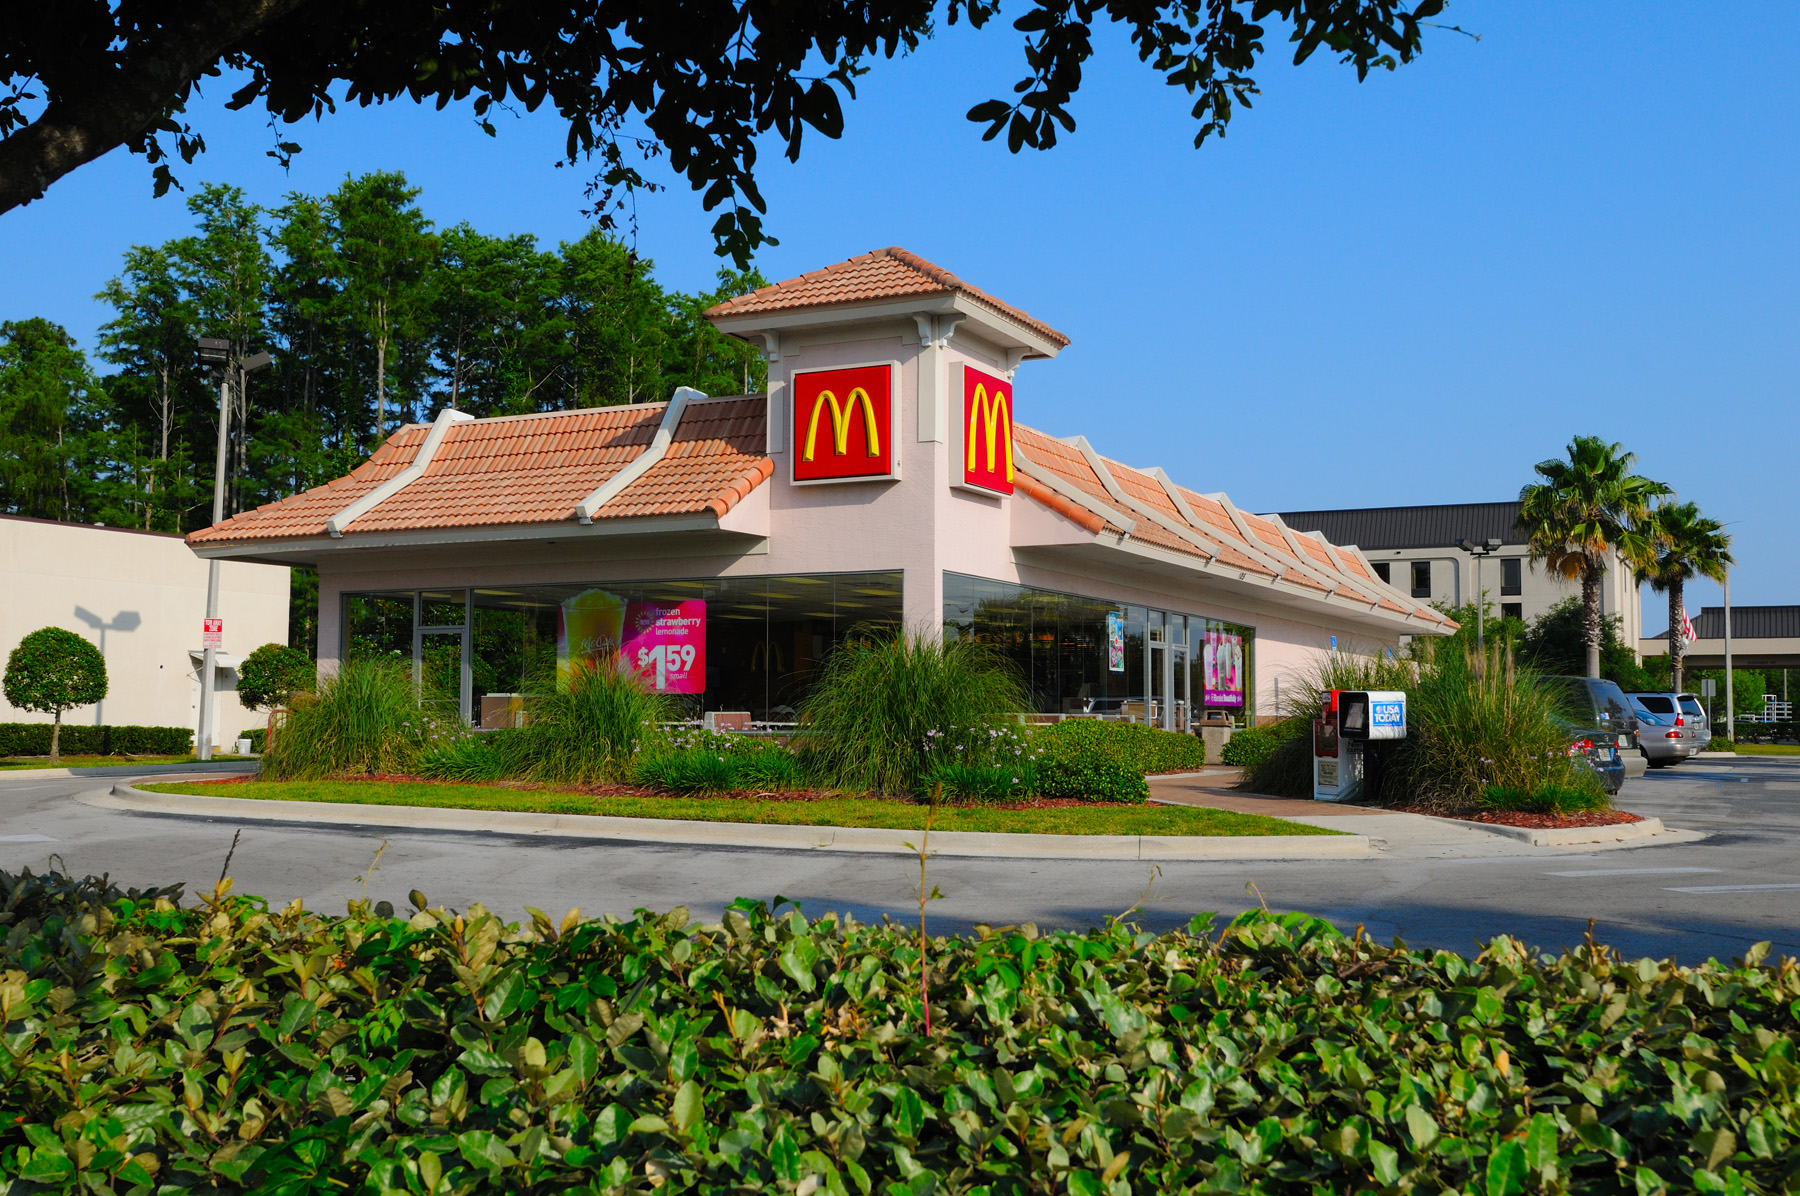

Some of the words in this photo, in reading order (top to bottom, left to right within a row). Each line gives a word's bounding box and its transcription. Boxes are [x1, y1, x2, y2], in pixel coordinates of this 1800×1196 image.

[655, 607, 680, 616] frozen
[655, 617, 701, 627] strawberry
[655, 627, 689, 636] lemonade
[1383, 705, 1400, 714] USA
[1375, 713, 1400, 723] TODAY
